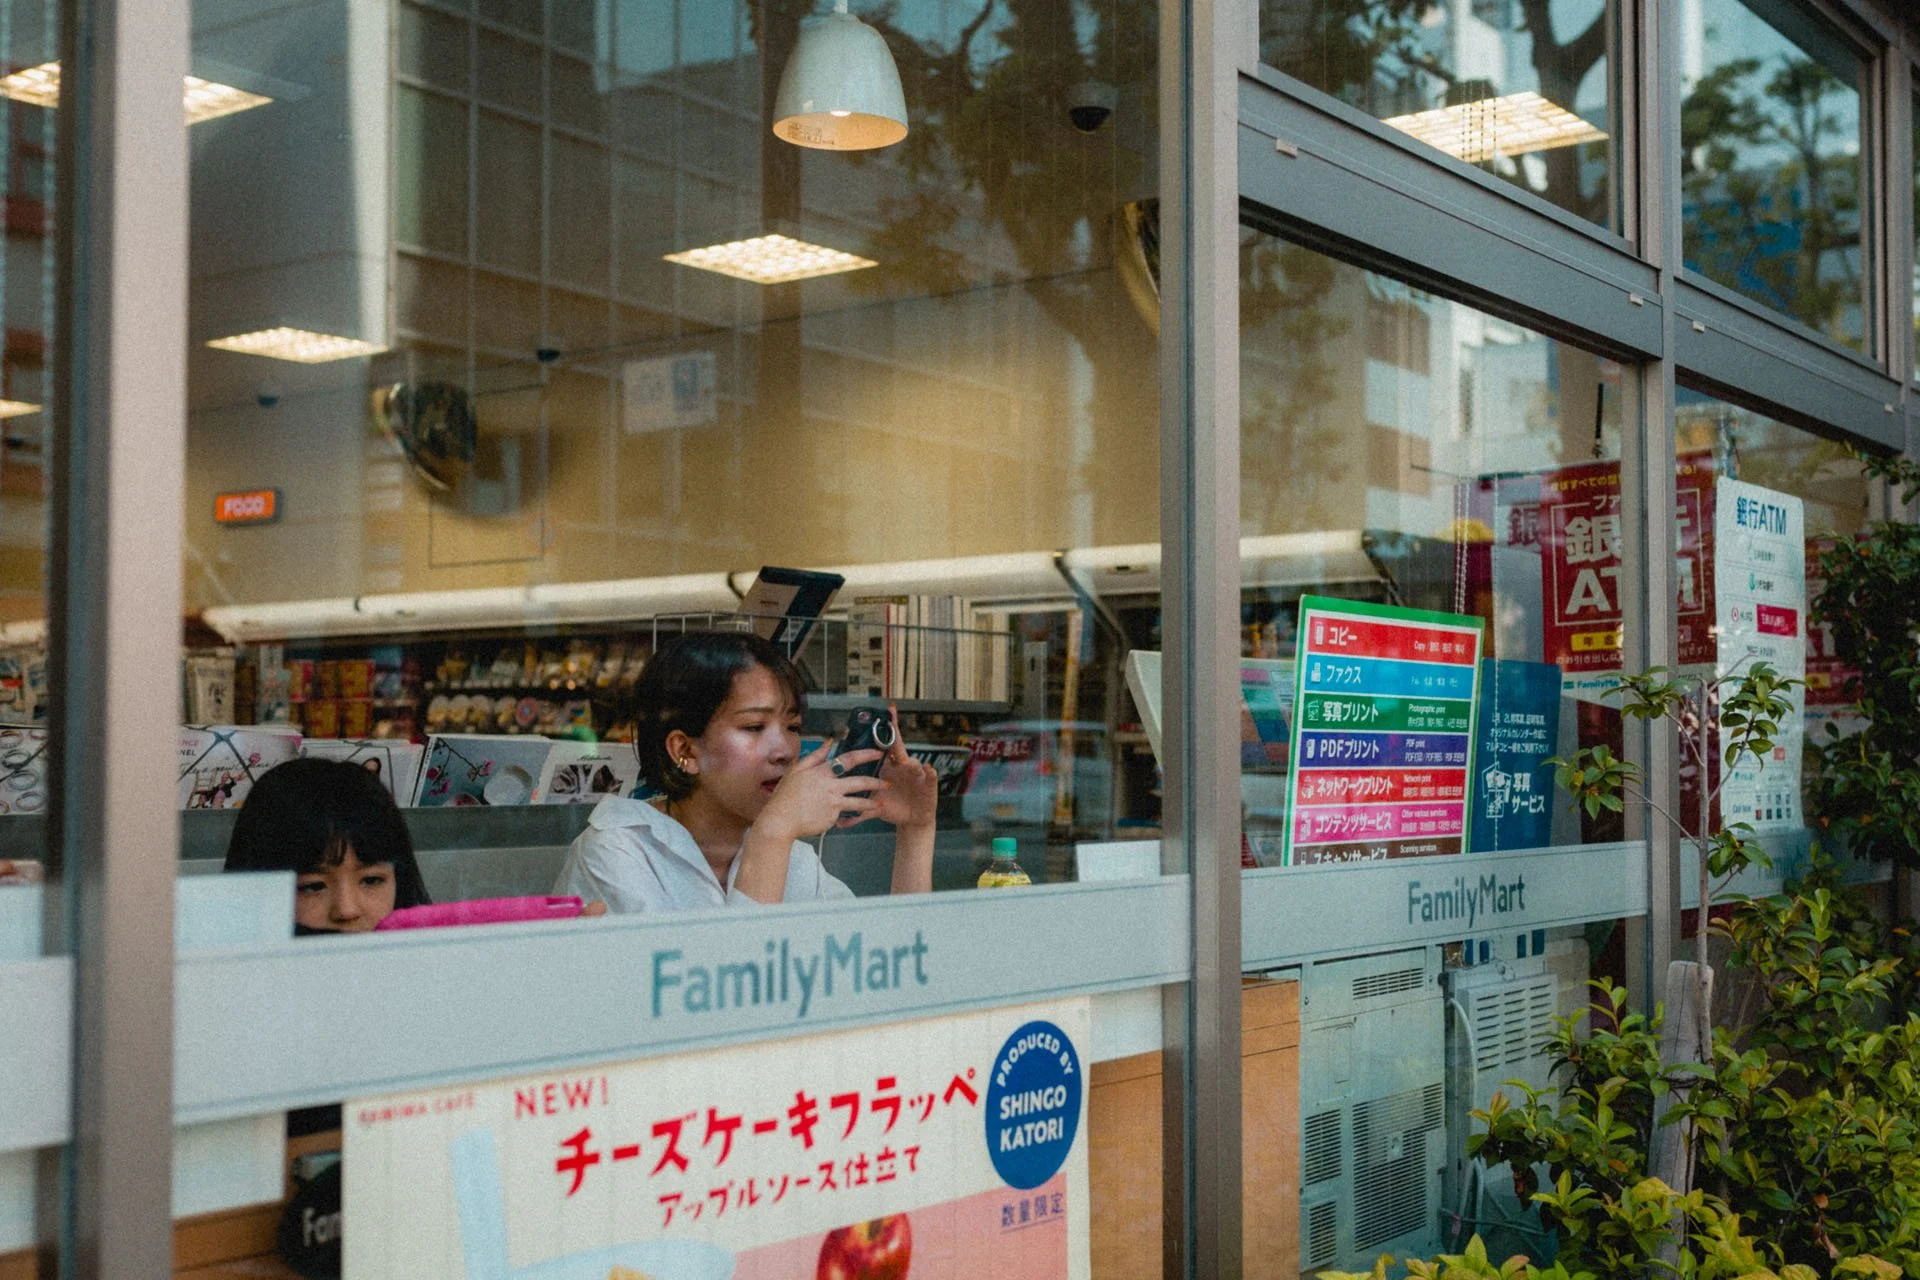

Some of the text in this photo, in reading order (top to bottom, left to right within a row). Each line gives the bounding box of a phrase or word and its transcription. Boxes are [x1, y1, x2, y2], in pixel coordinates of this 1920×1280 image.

[1736, 496, 1787, 535] 銀行ATM
[1328, 626, 1358, 646] コピー
[1326, 665, 1362, 685] ファクス
[1322, 701, 1379, 723] 写真プリント
[1319, 738, 1379, 759] PDFプリント
[1317, 775, 1393, 797] ネットワークプリント
[1512, 772, 1532, 792] 写真
[1315, 811, 1393, 834] コンテンツサービス
[1511, 795, 1545, 814] サービス
[1407, 873, 1526, 928] FamilyMart
[652, 929, 929, 1018] FamilyMart
[996, 1032, 1075, 1087] PRODUCED BY
[514, 1076, 609, 1120] NEW!
[1000, 1084, 1067, 1120] SHINGO
[555, 1067, 980, 1198] チーズケーキフラッペ
[1000, 1116, 1064, 1152] KATORI
[657, 1145, 921, 1229] アップルソース仕立て
[1001, 1192, 1064, 1229] 数量限定
